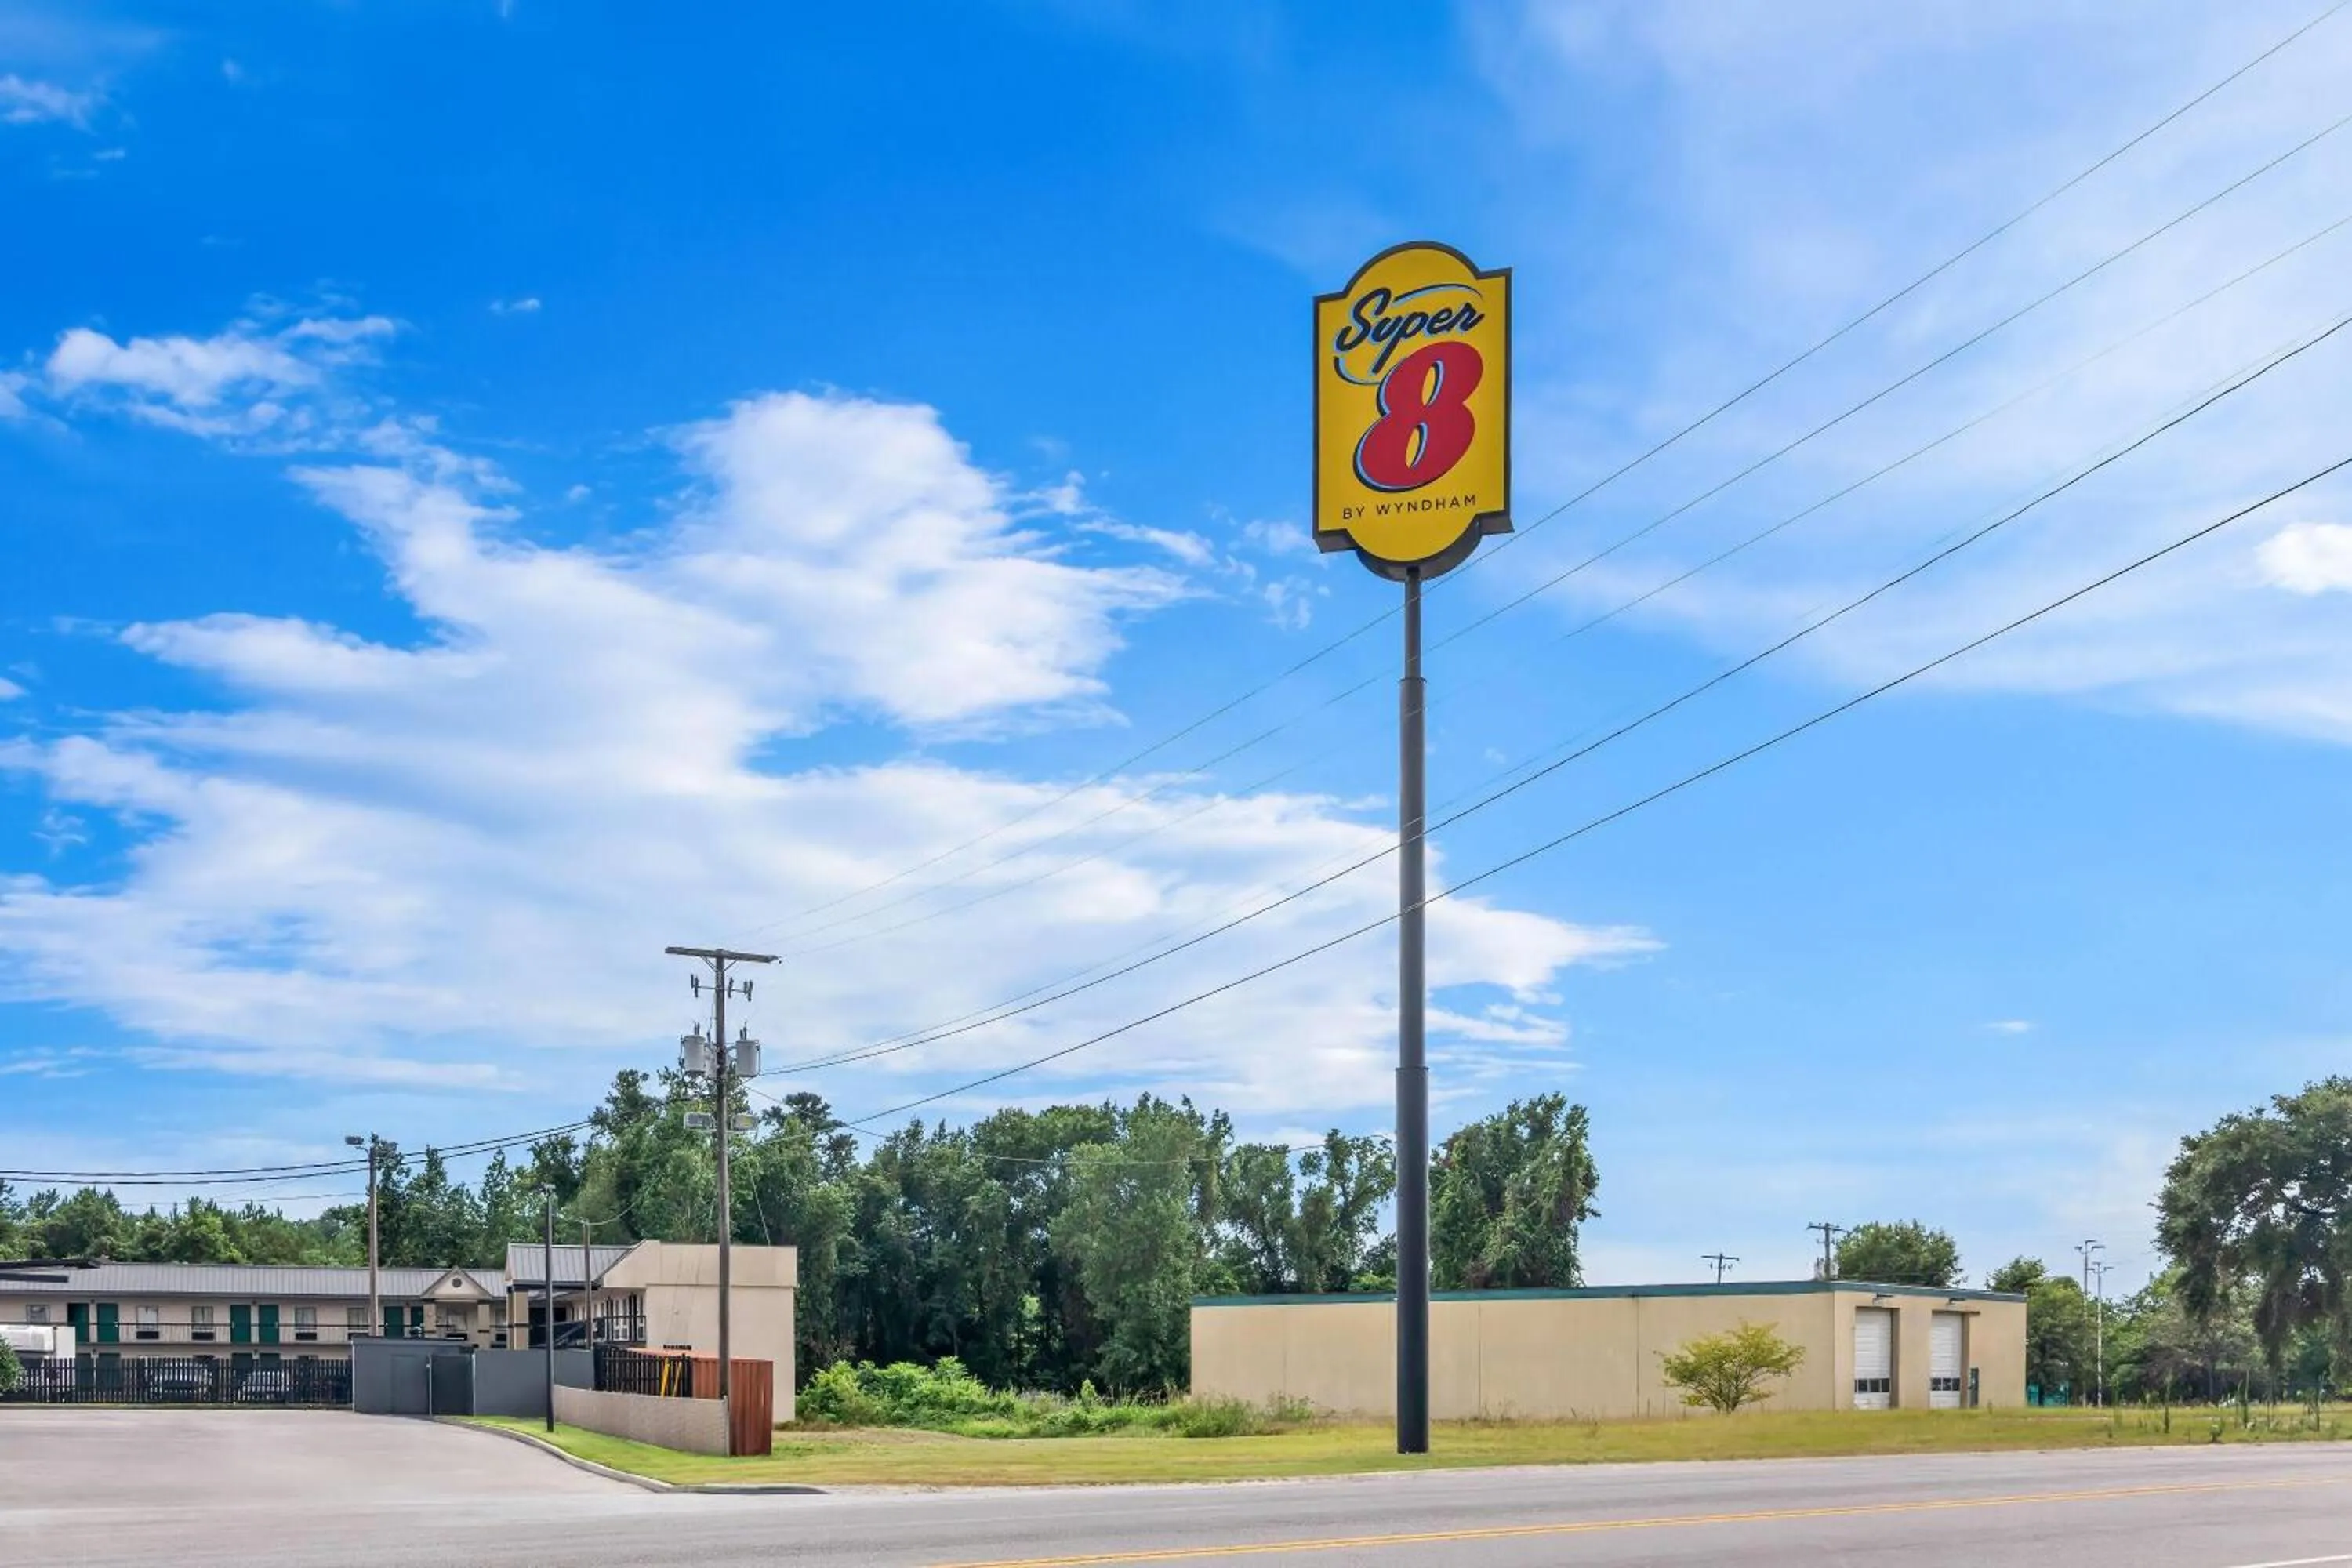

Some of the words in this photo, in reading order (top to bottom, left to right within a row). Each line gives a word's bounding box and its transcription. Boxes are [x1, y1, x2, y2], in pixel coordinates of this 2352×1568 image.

[1334, 287, 1485, 376] Super
[1352, 340, 1483, 493] 8
[1342, 506, 1365, 520] BY
[1376, 495, 1476, 515] WYNDHAM
